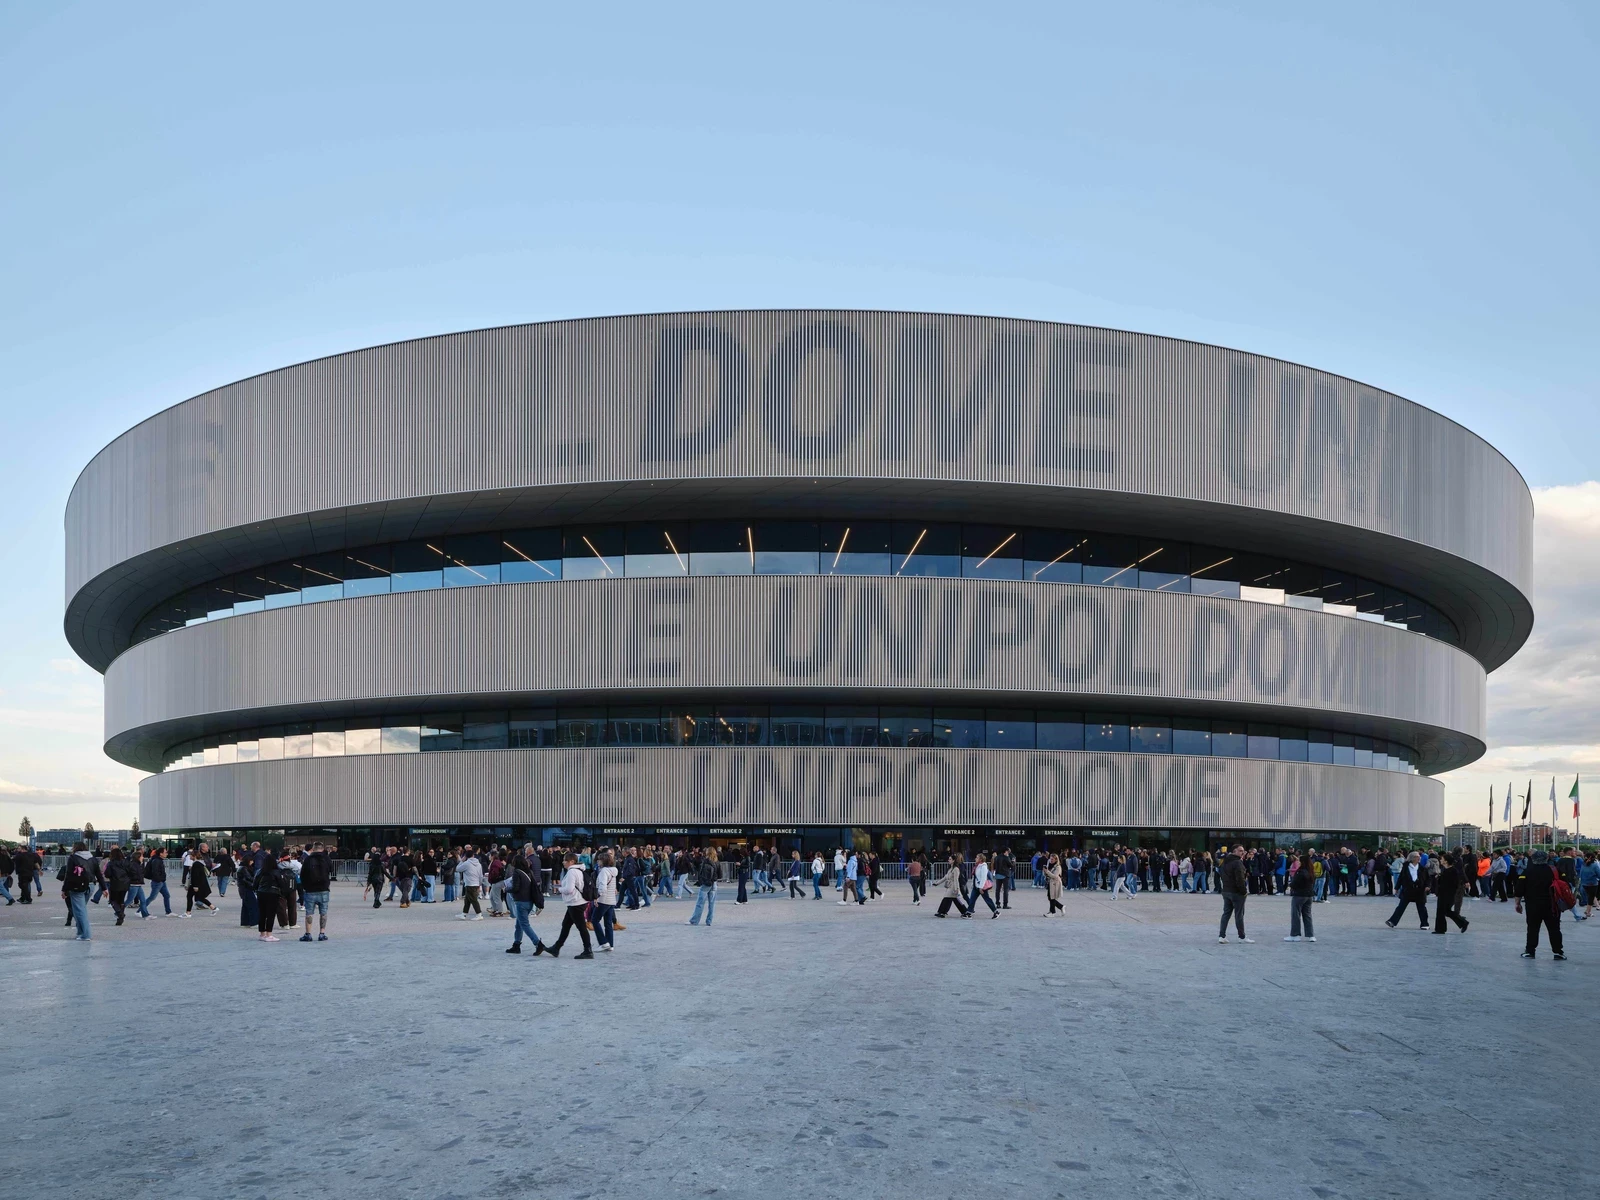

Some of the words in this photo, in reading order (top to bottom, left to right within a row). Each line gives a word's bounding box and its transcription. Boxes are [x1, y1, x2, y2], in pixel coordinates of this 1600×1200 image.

[639, 319, 1134, 474] DOME
[766, 581, 1162, 688] UNIPOL
[692, 754, 998, 822] UNIPOL
[1023, 756, 1227, 824] DOME
